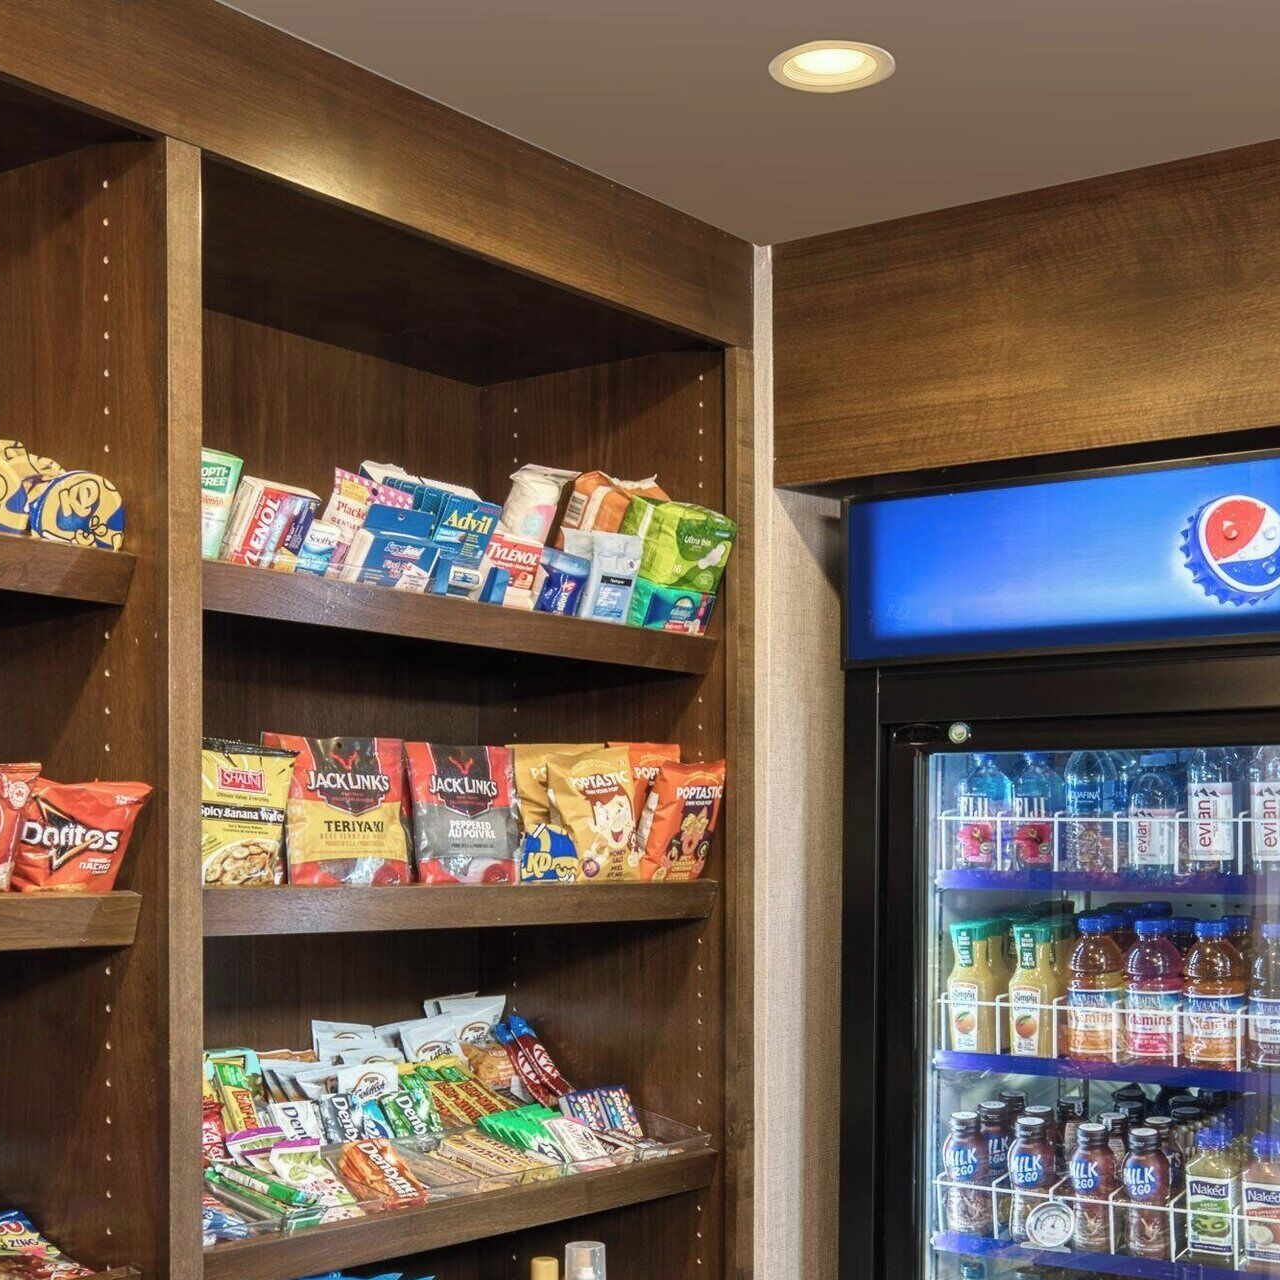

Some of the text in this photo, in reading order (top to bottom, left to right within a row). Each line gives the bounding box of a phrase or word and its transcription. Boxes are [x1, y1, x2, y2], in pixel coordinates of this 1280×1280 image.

[58, 480, 100, 517] KD
[444, 510, 490, 534] Advil
[308, 533, 336, 545] Soothe
[487, 542, 539, 564] TYLENOL
[222, 770, 262, 790] SHAUNI
[307, 771, 389, 791] JACK LINK'S
[430, 775, 466, 793] JACK
[570, 772, 629, 790] POPTASTIC
[676, 785, 722, 799] POPTASTIC
[202, 806, 258, 820] Spicy Banana
[325, 820, 384, 832] TERIYAKI
[450, 820, 492, 831] PEPPERED
[1199, 800, 1212, 847] evian
[1264, 799, 1278, 847] evian
[22, 821, 120, 851] Doritos
[448, 830, 496, 839] AU POIVRE
[1137, 820, 1147, 853] evian
[527, 852, 552, 877] KD
[1014, 993, 1037, 1003] Simply
[946, 1148, 977, 1165] MILK
[1011, 1154, 1042, 1172] MILK
[954, 1165, 973, 1175] 2GO
[1019, 1172, 1038, 1183] 2GO
[1070, 1161, 1099, 1178] MILK
[1124, 1166, 1155, 1184] MILK
[1075, 1179, 1094, 1189] 2GO
[1131, 1185, 1151, 1195] 2GO
